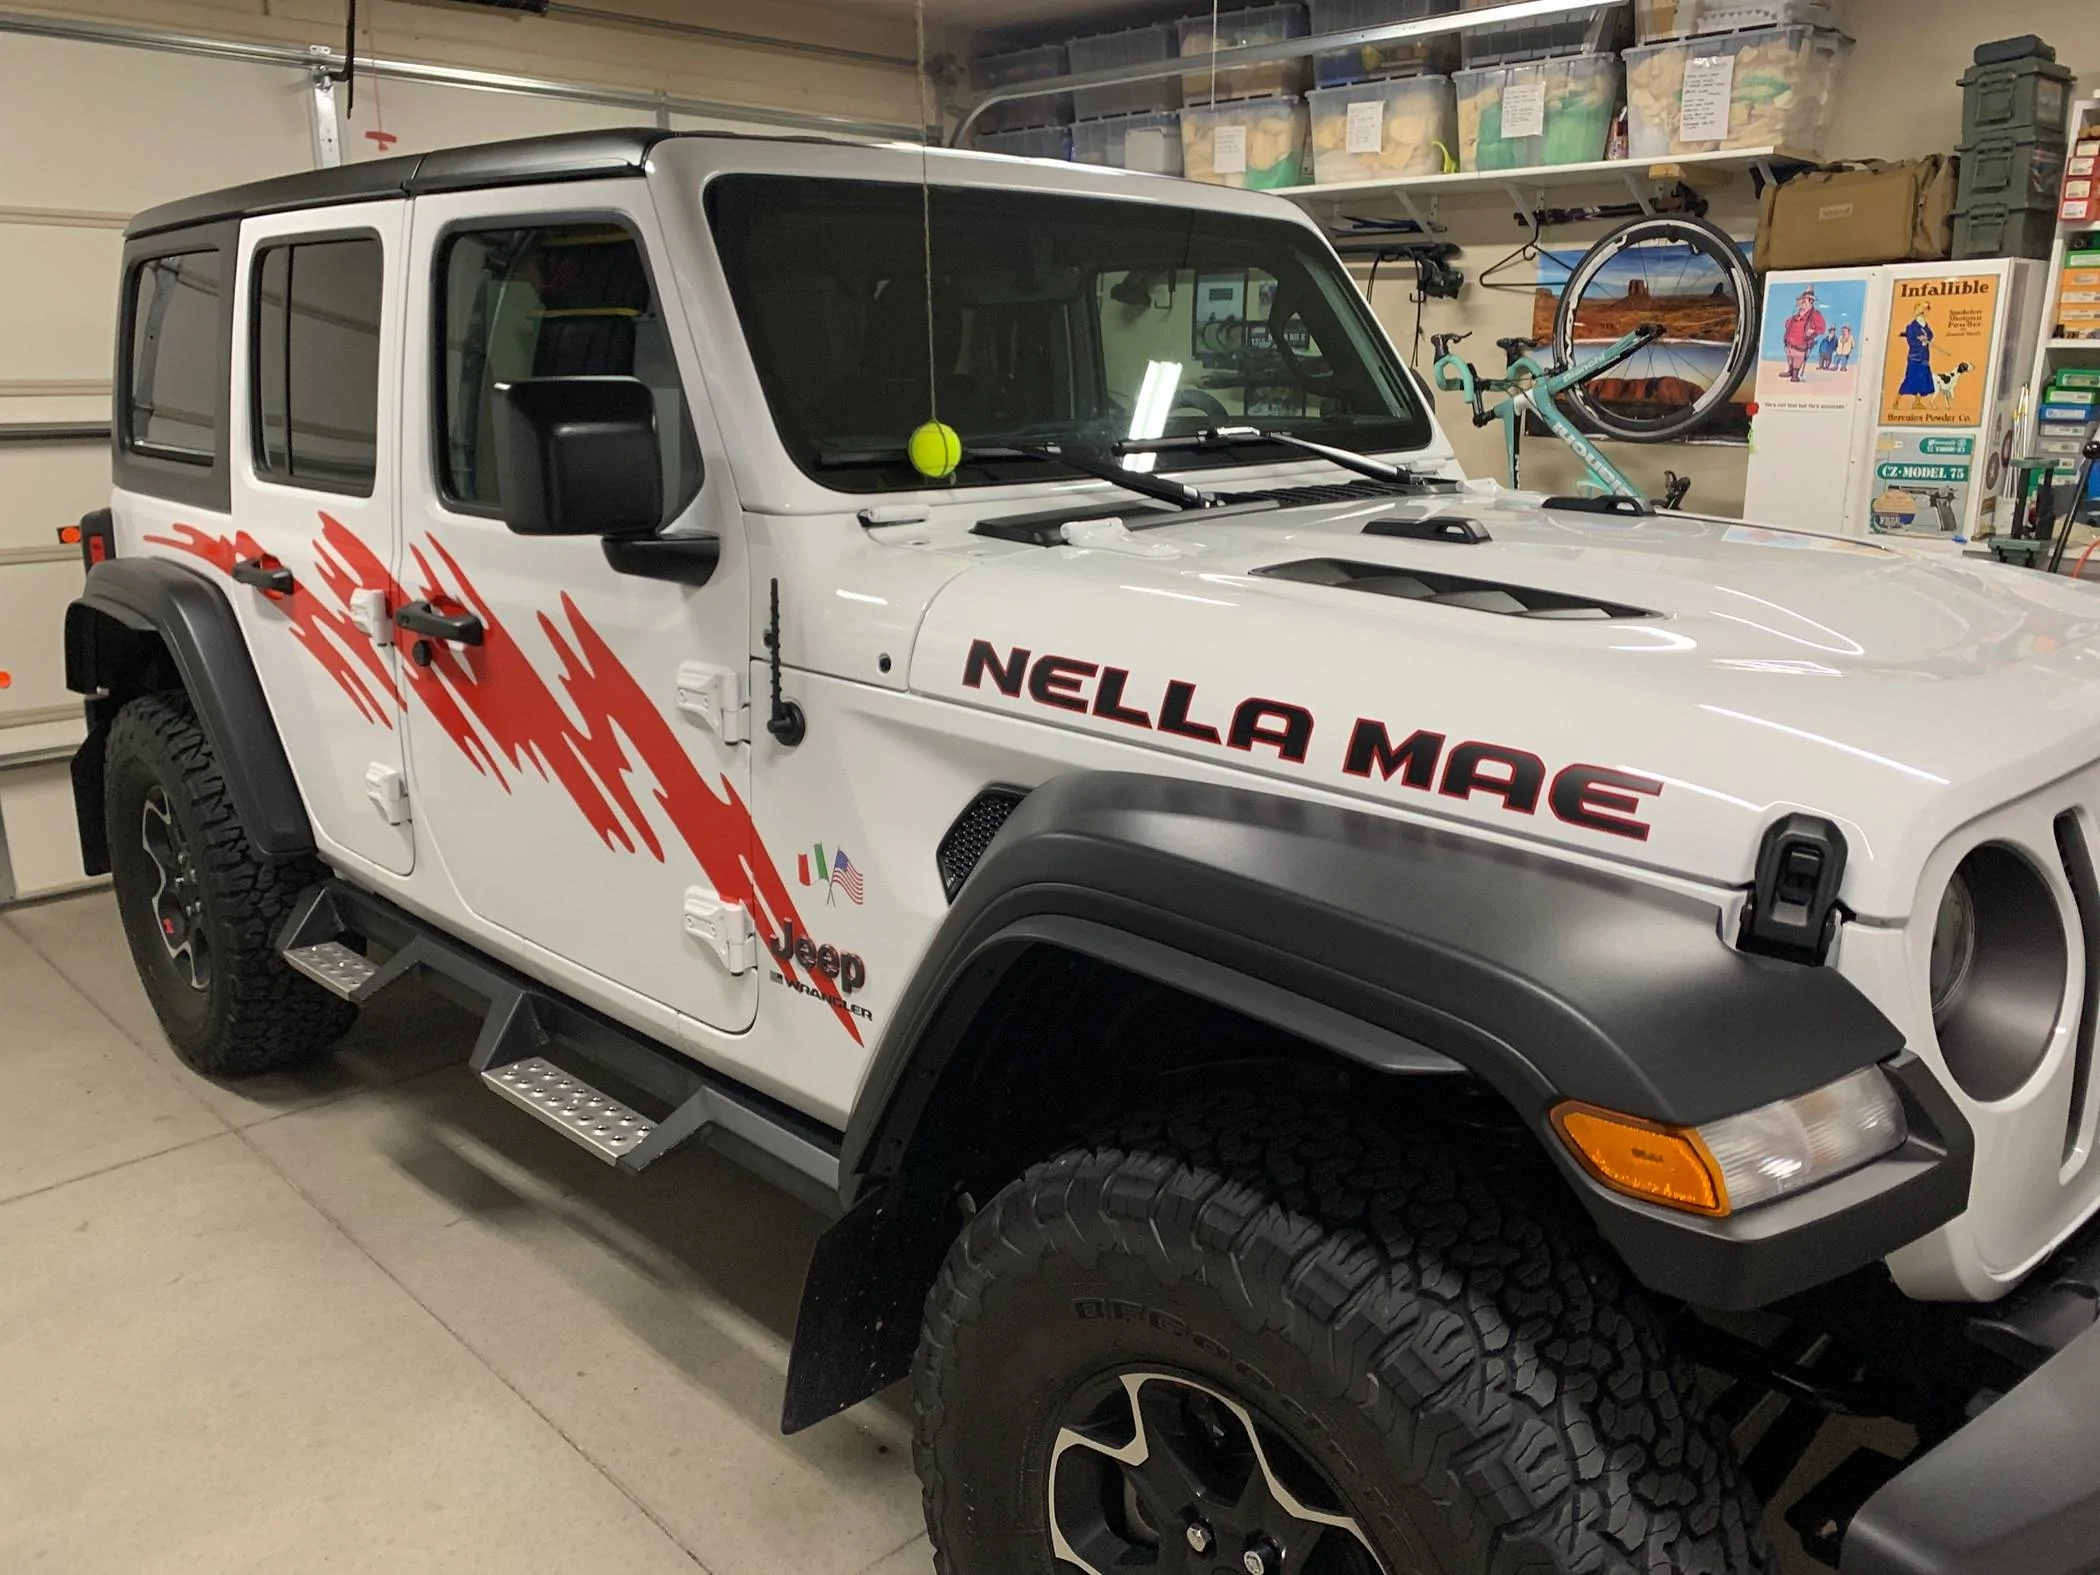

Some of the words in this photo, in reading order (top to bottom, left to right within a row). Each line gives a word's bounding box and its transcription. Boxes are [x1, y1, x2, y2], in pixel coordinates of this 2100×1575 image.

[1900, 279, 1990, 298] Infallible
[1887, 413, 1923, 422] Hercules
[1925, 413, 1956, 422] Powder
[1950, 467, 1964, 479] 75
[962, 638, 1315, 764] NELLA
[1343, 717, 1664, 841] MAE
[769, 917, 866, 994] Jeep
[783, 977, 873, 1021] WRANGLER
